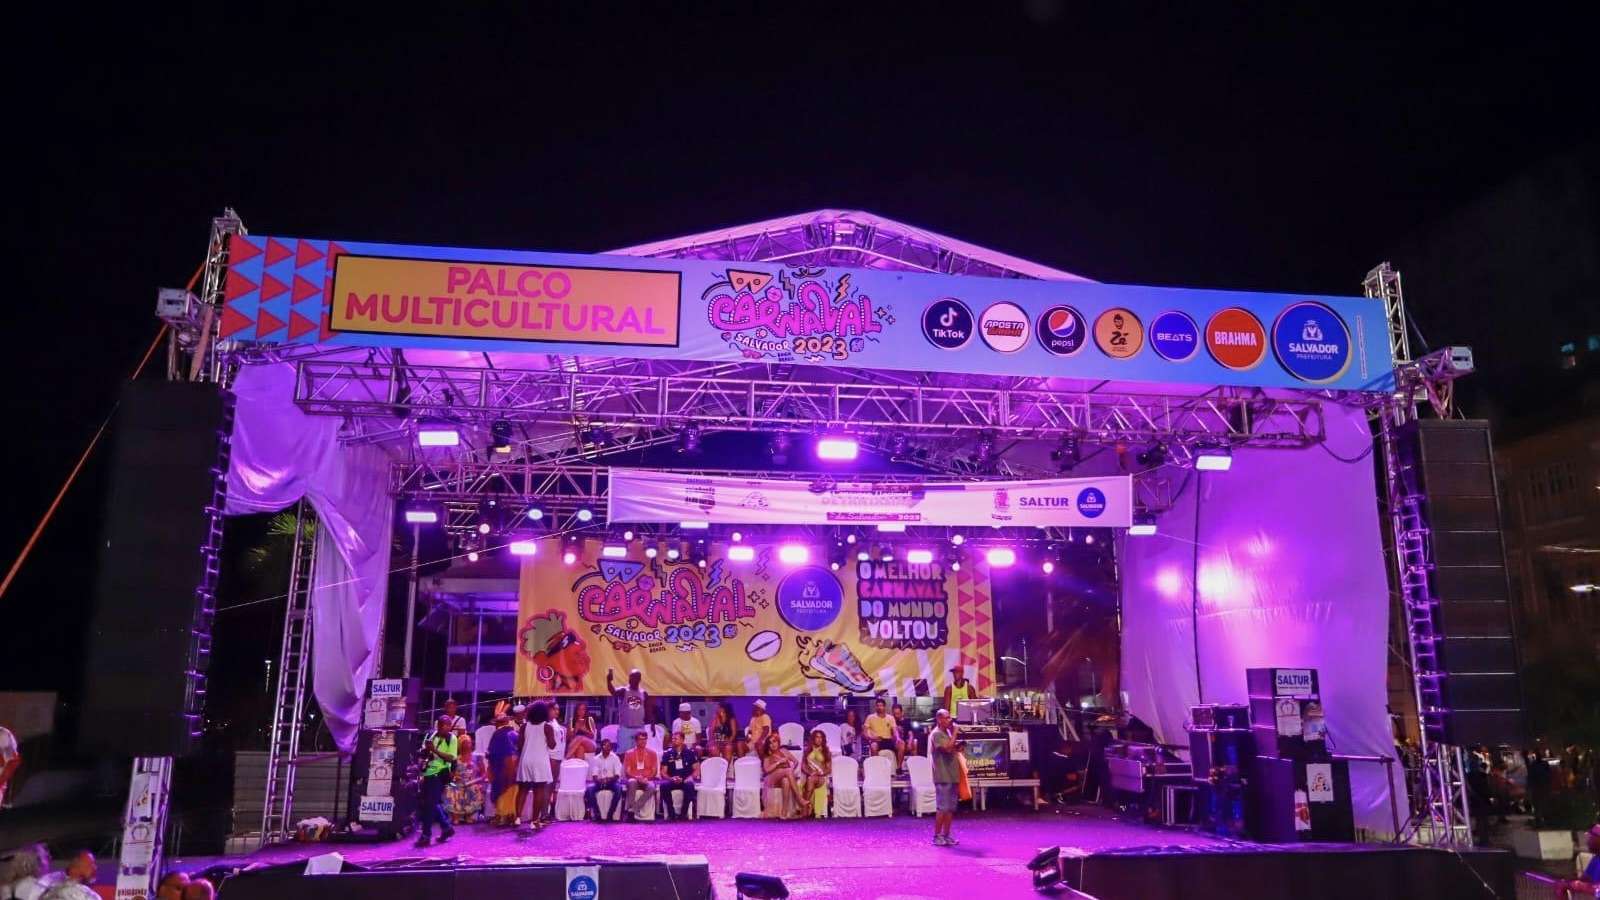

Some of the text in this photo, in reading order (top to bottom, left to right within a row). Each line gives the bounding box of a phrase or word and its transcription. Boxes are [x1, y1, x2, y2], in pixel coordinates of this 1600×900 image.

[447, 266, 572, 299] PALCO
[345, 292, 665, 335] MULTICULTURAL
[707, 281, 882, 338] CARNAVAL
[985, 319, 1025, 330] APOSTA
[932, 328, 965, 340] TikTok
[1157, 332, 1193, 342] BEATS
[1214, 330, 1257, 347] BRAHMA
[735, 333, 792, 351] SALVADOR
[792, 334, 848, 361] 2023
[1051, 338, 1075, 348] pepsi
[1288, 342, 1339, 355] SALVADOR
[1019, 496, 1069, 507] SALTUR
[860, 562, 942, 580] O MELHOR
[577, 567, 756, 628] CARNAVAL
[860, 580, 945, 598] CARNAVAL
[790, 599, 833, 609] SALVADOR
[860, 600, 946, 618] DO MUNDO
[604, 622, 721, 649] SALVADOR 2023
[867, 619, 938, 640] VOLTOU
[372, 683, 401, 693] SALTUR
[1277, 674, 1310, 686] SALTUR
[361, 801, 393, 812] SALTUR
